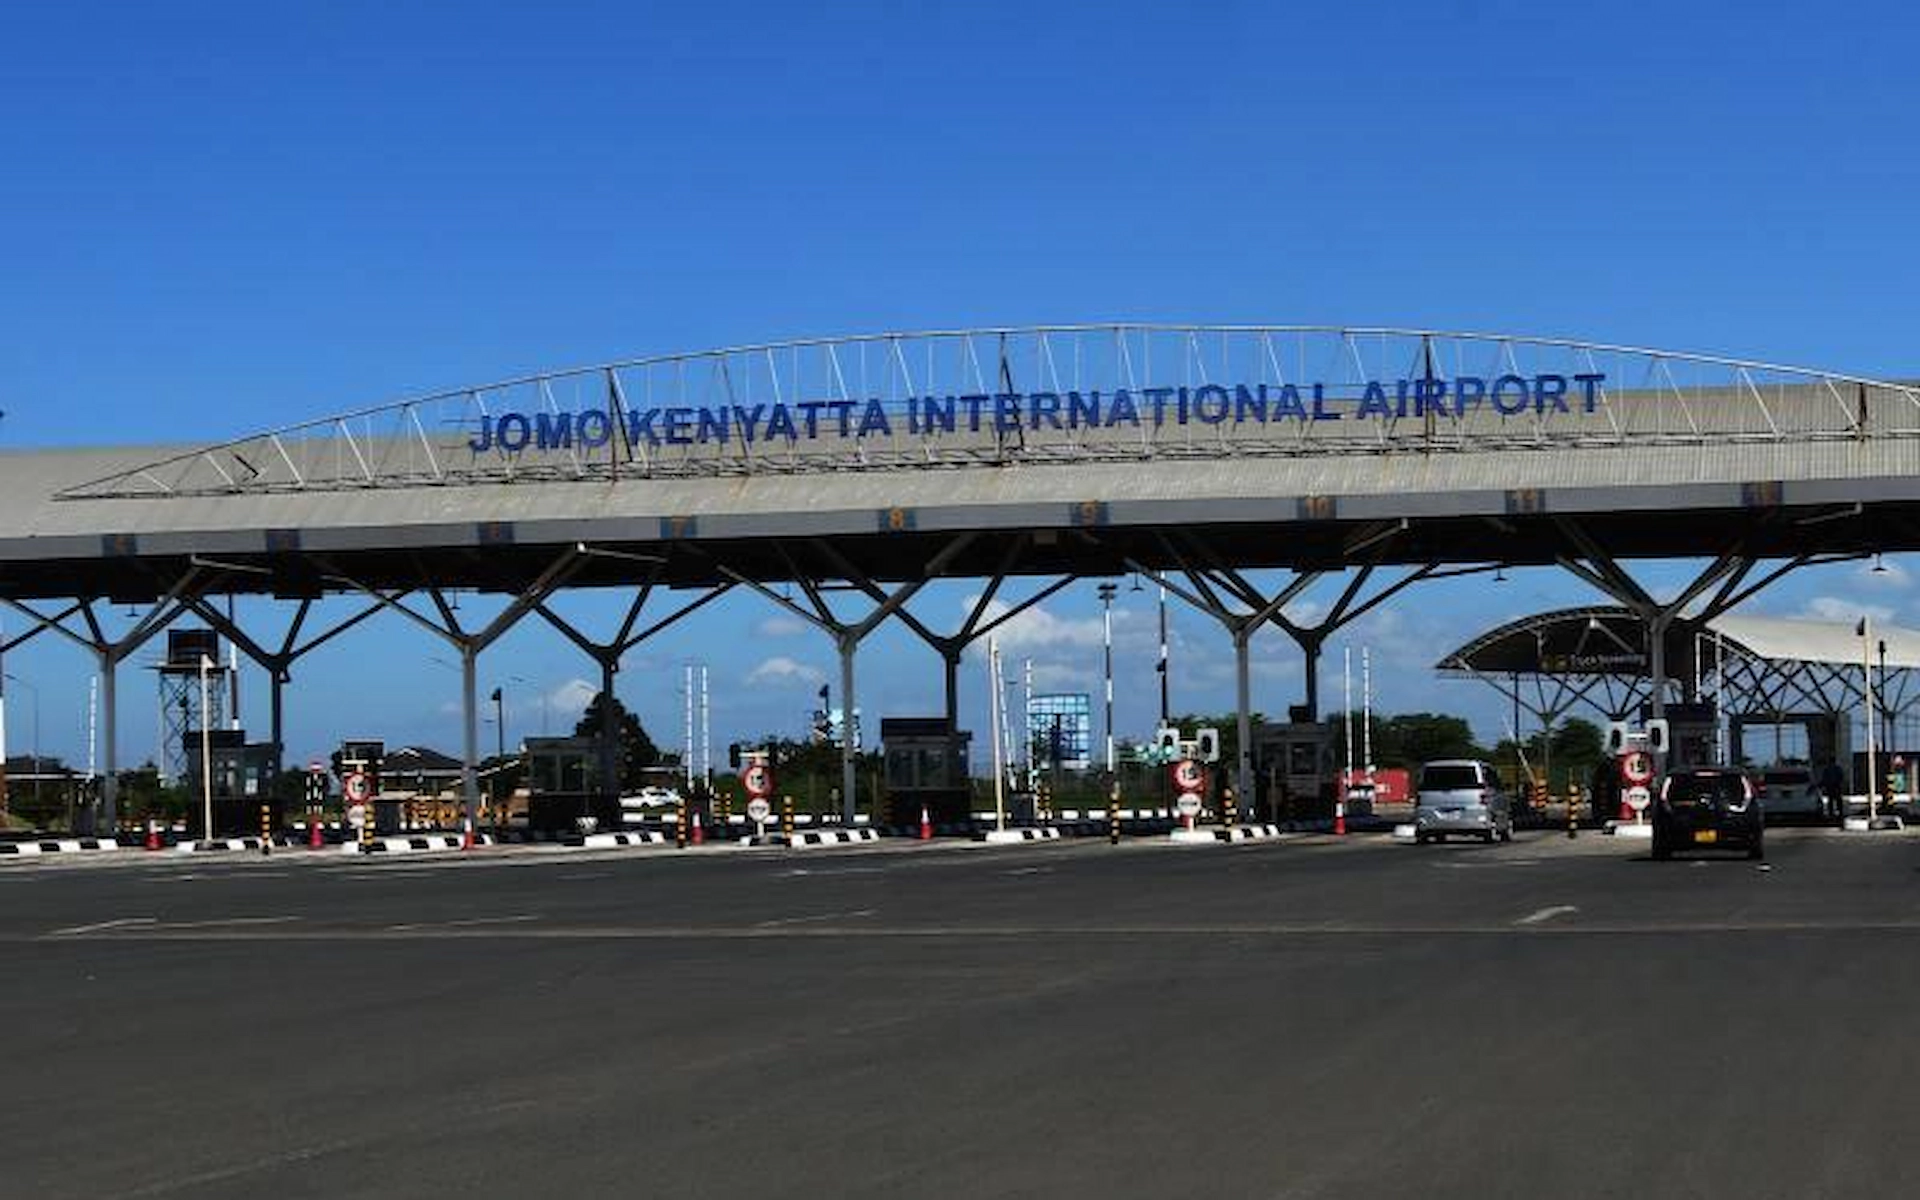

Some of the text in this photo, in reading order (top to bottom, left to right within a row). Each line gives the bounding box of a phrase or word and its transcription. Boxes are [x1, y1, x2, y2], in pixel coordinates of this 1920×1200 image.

[469, 374, 1604, 452] JOMO KENYATTA INTERNATIONAL AIRPORT
[889, 508, 904, 529] 8
